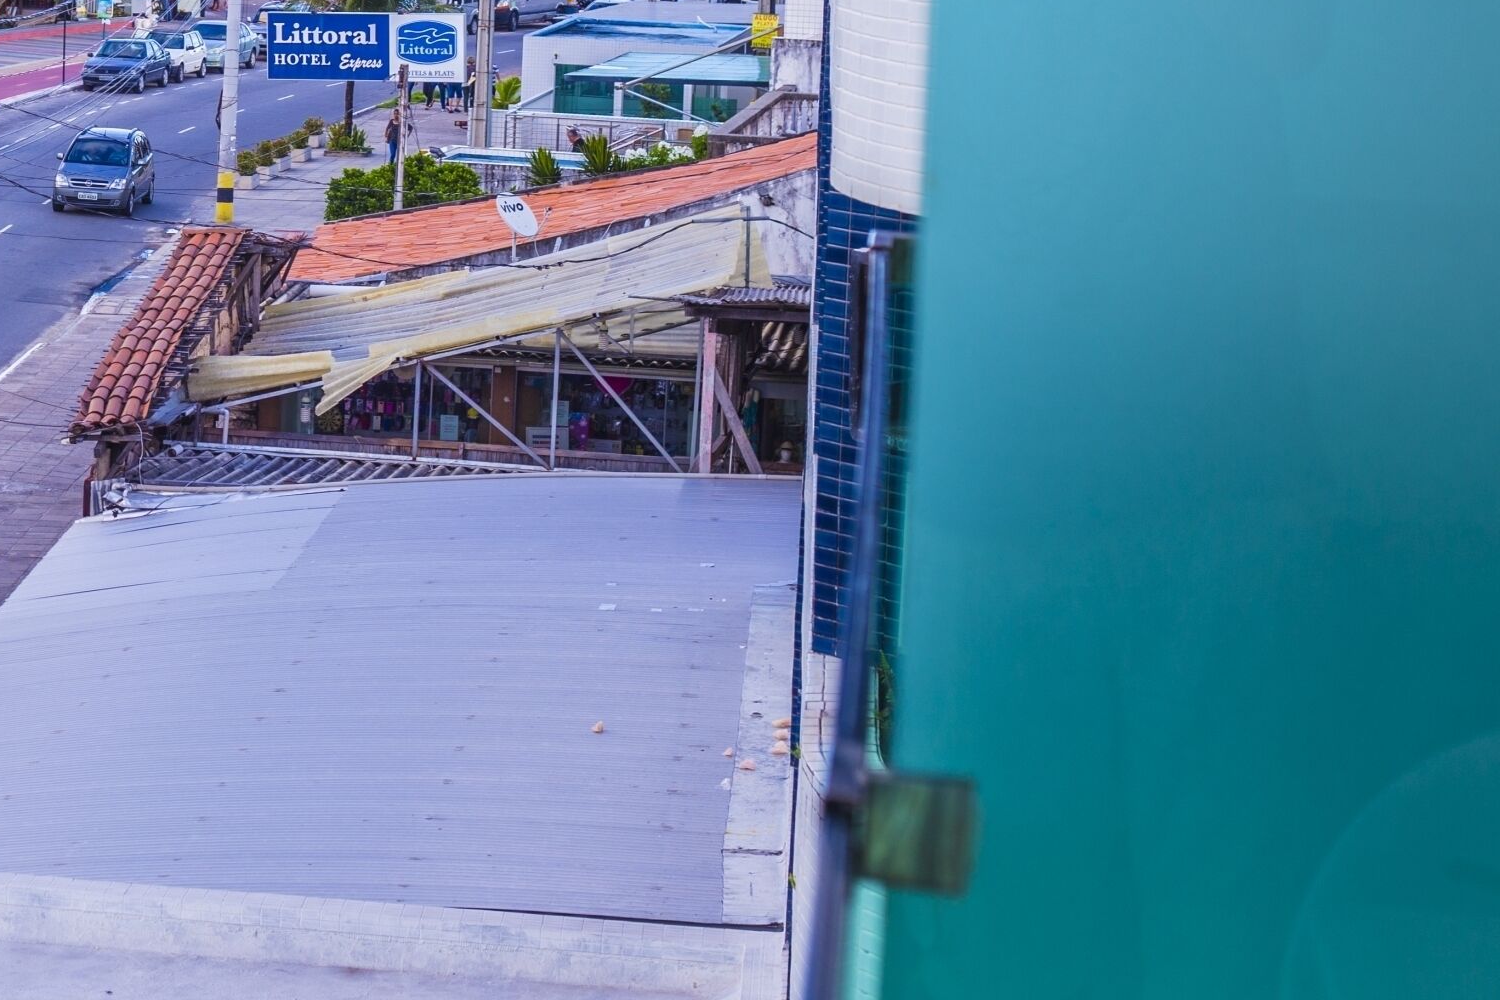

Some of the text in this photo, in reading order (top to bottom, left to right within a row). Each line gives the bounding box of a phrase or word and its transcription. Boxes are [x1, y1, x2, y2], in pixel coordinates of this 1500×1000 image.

[273, 22, 378, 45] Littoral
[400, 43, 453, 55] Littoral
[274, 53, 383, 72] HOTEL Express
[500, 200, 524, 213] vivo
